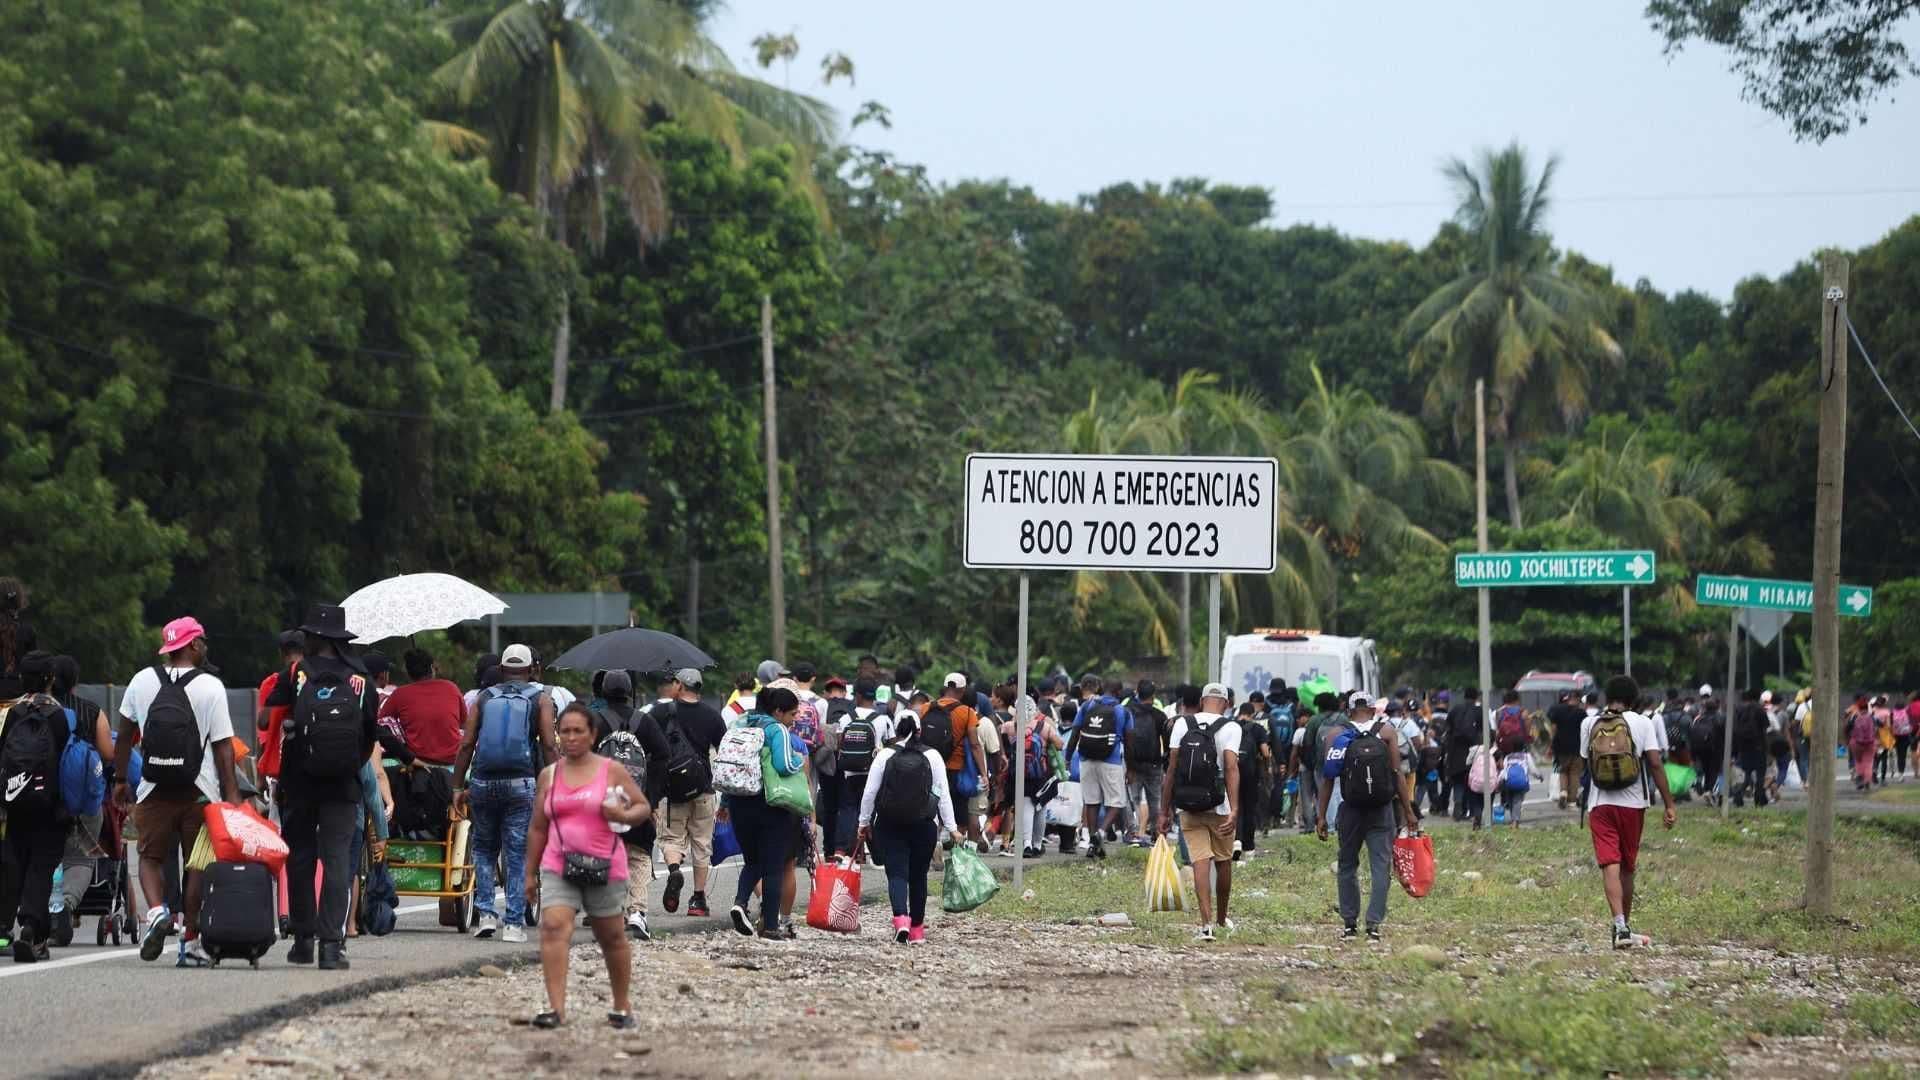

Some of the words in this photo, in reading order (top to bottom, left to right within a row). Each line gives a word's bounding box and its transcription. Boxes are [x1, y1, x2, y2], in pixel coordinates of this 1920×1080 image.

[981, 469, 1085, 504] ATENCION
[1092, 471, 1106, 505] A
[1114, 471, 1260, 507] EMERGENCIAS
[1020, 519, 1072, 554] 800
[1084, 521, 1136, 555] 700
[1147, 522, 1219, 557] 2023
[1459, 560, 1511, 580] BARRIO
[1520, 558, 1614, 578] XOCHILTEPEC
[1705, 583, 1749, 601] UNION
[1760, 587, 1814, 607] MIRAMA
[1327, 747, 1347, 760] tel
[8, 772, 26, 791] NIKE
